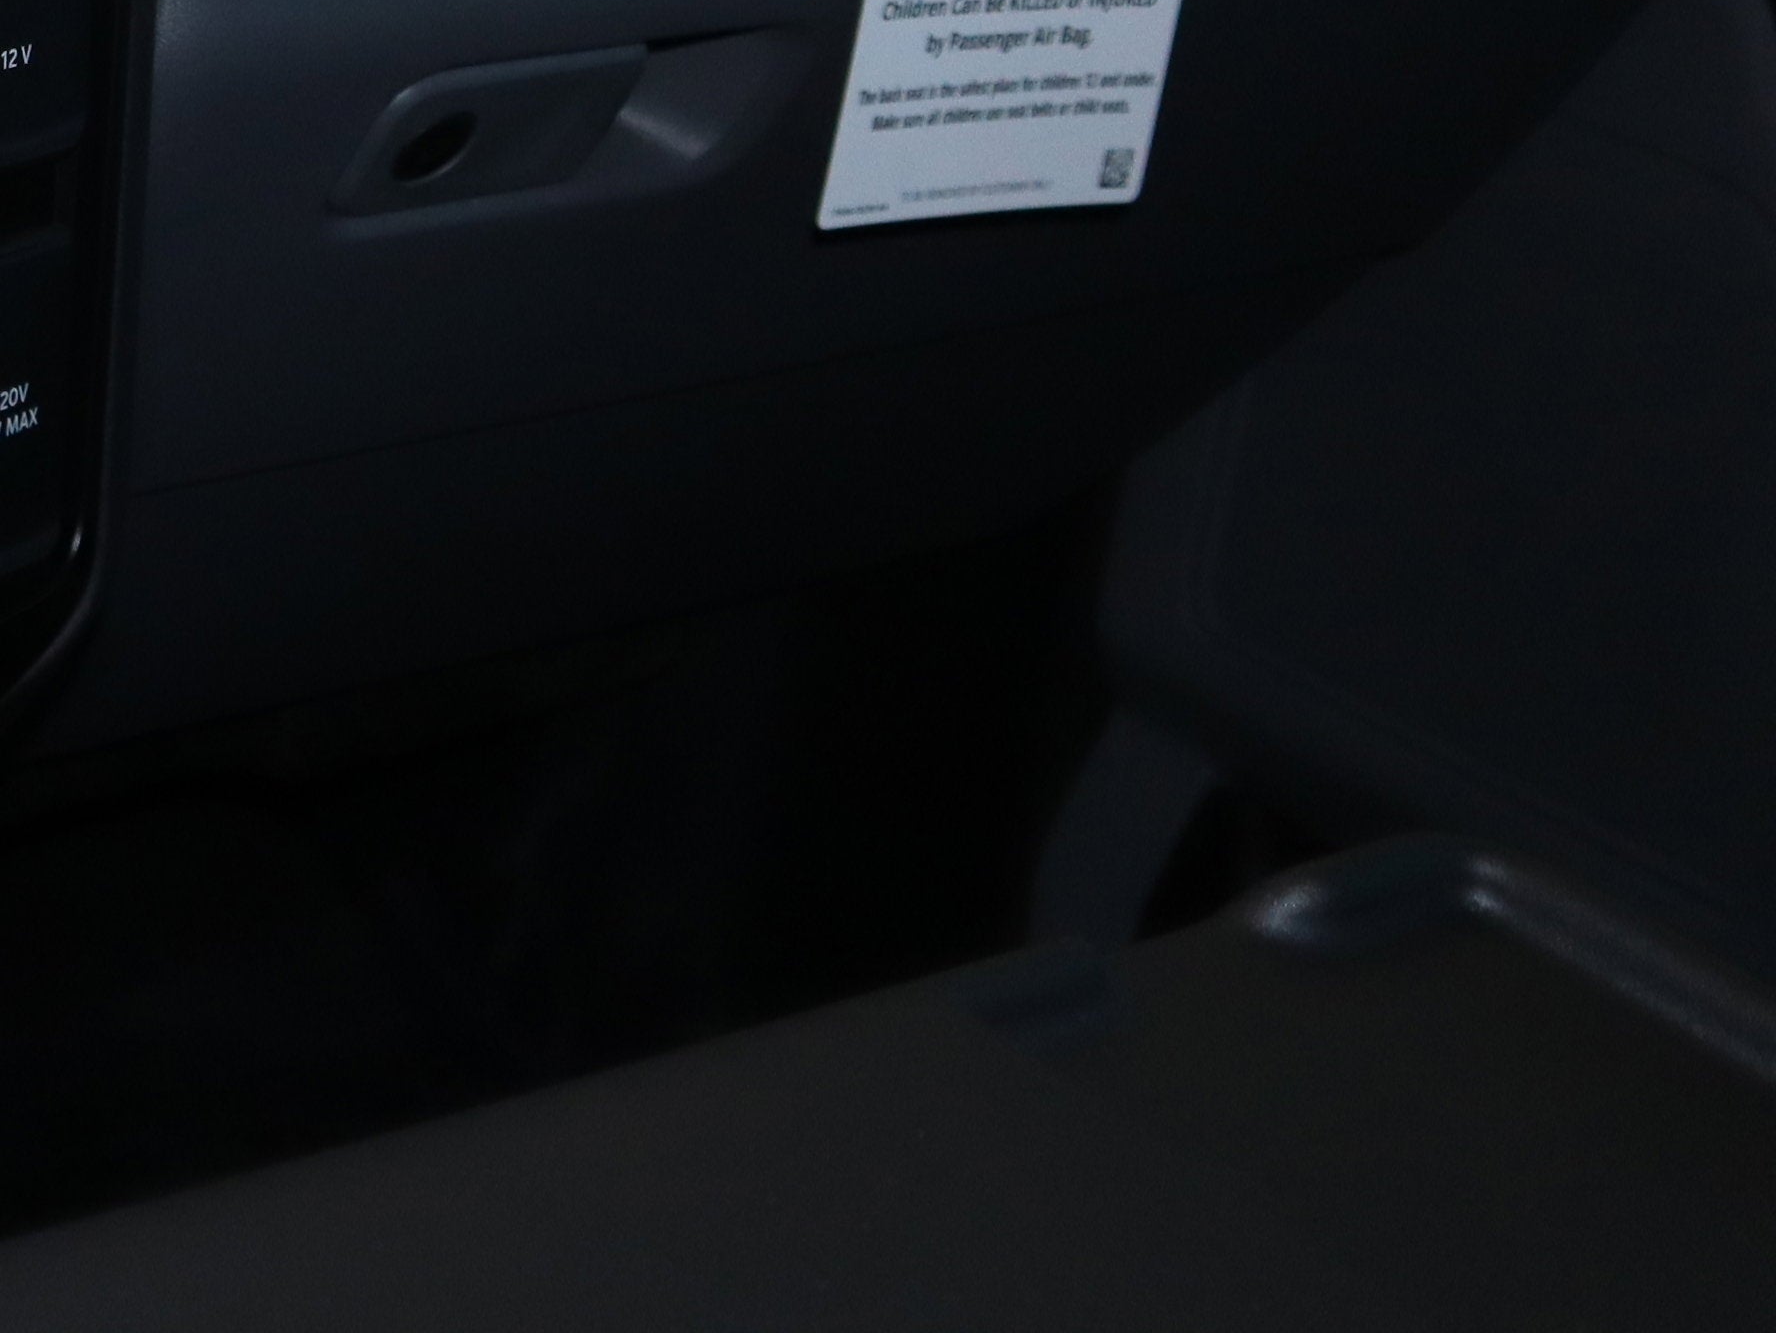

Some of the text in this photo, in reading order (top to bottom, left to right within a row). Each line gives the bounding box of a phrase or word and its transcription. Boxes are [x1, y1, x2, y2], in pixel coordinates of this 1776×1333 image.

[882, 0, 948, 21] Children
[925, 34, 946, 59] by
[949, 32, 1030, 53] Passenger
[1032, 27, 1057, 47] Air
[4, 405, 39, 437] MAX
